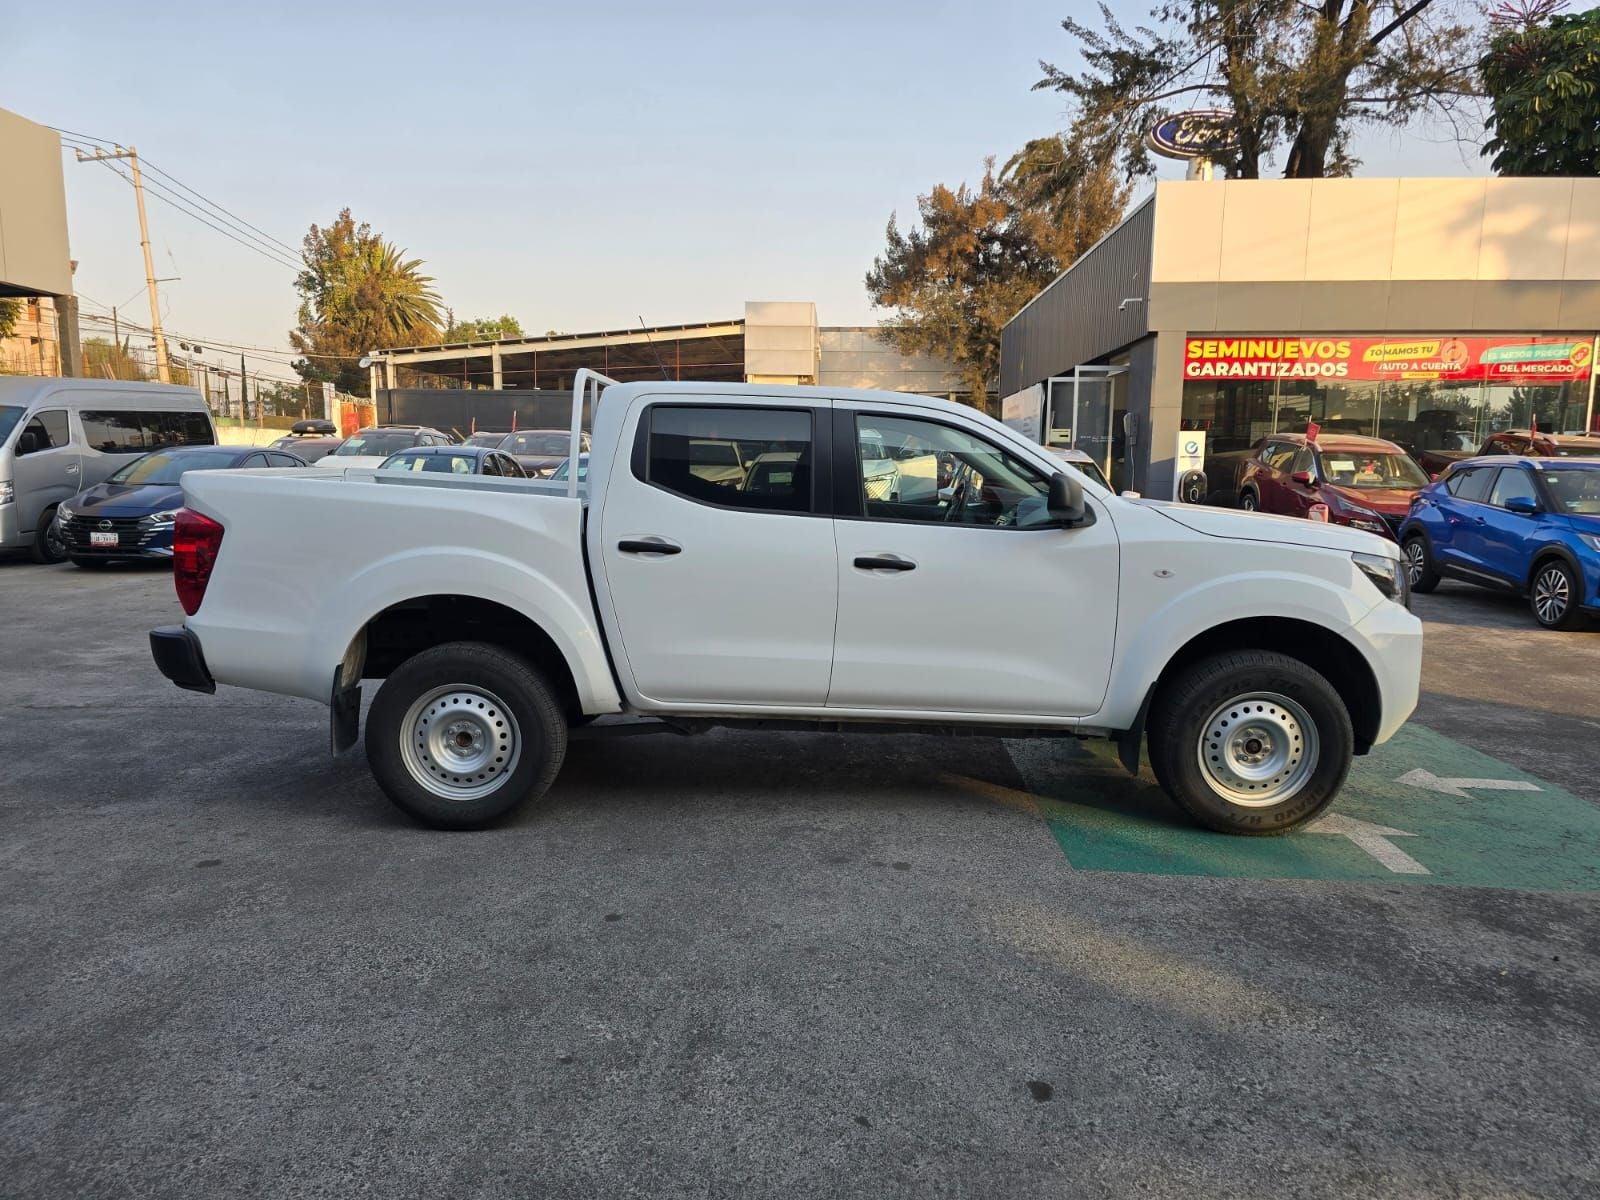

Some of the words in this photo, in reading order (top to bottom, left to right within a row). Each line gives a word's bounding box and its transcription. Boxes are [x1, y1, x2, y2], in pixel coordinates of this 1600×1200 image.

[1187, 340, 1351, 359] SEMINUEVOS
[1370, 347, 1419, 357] TOMAMOS
[1421, 346, 1434, 354] TU
[1500, 350, 1533, 358] MEJOR
[1186, 362, 1348, 377] GARANTIZADOS
[1379, 363, 1409, 371] AUTO
[1421, 362, 1462, 370] CUENTA
[1499, 365, 1520, 373] DEL
[1521, 365, 1574, 373] MERCADO
